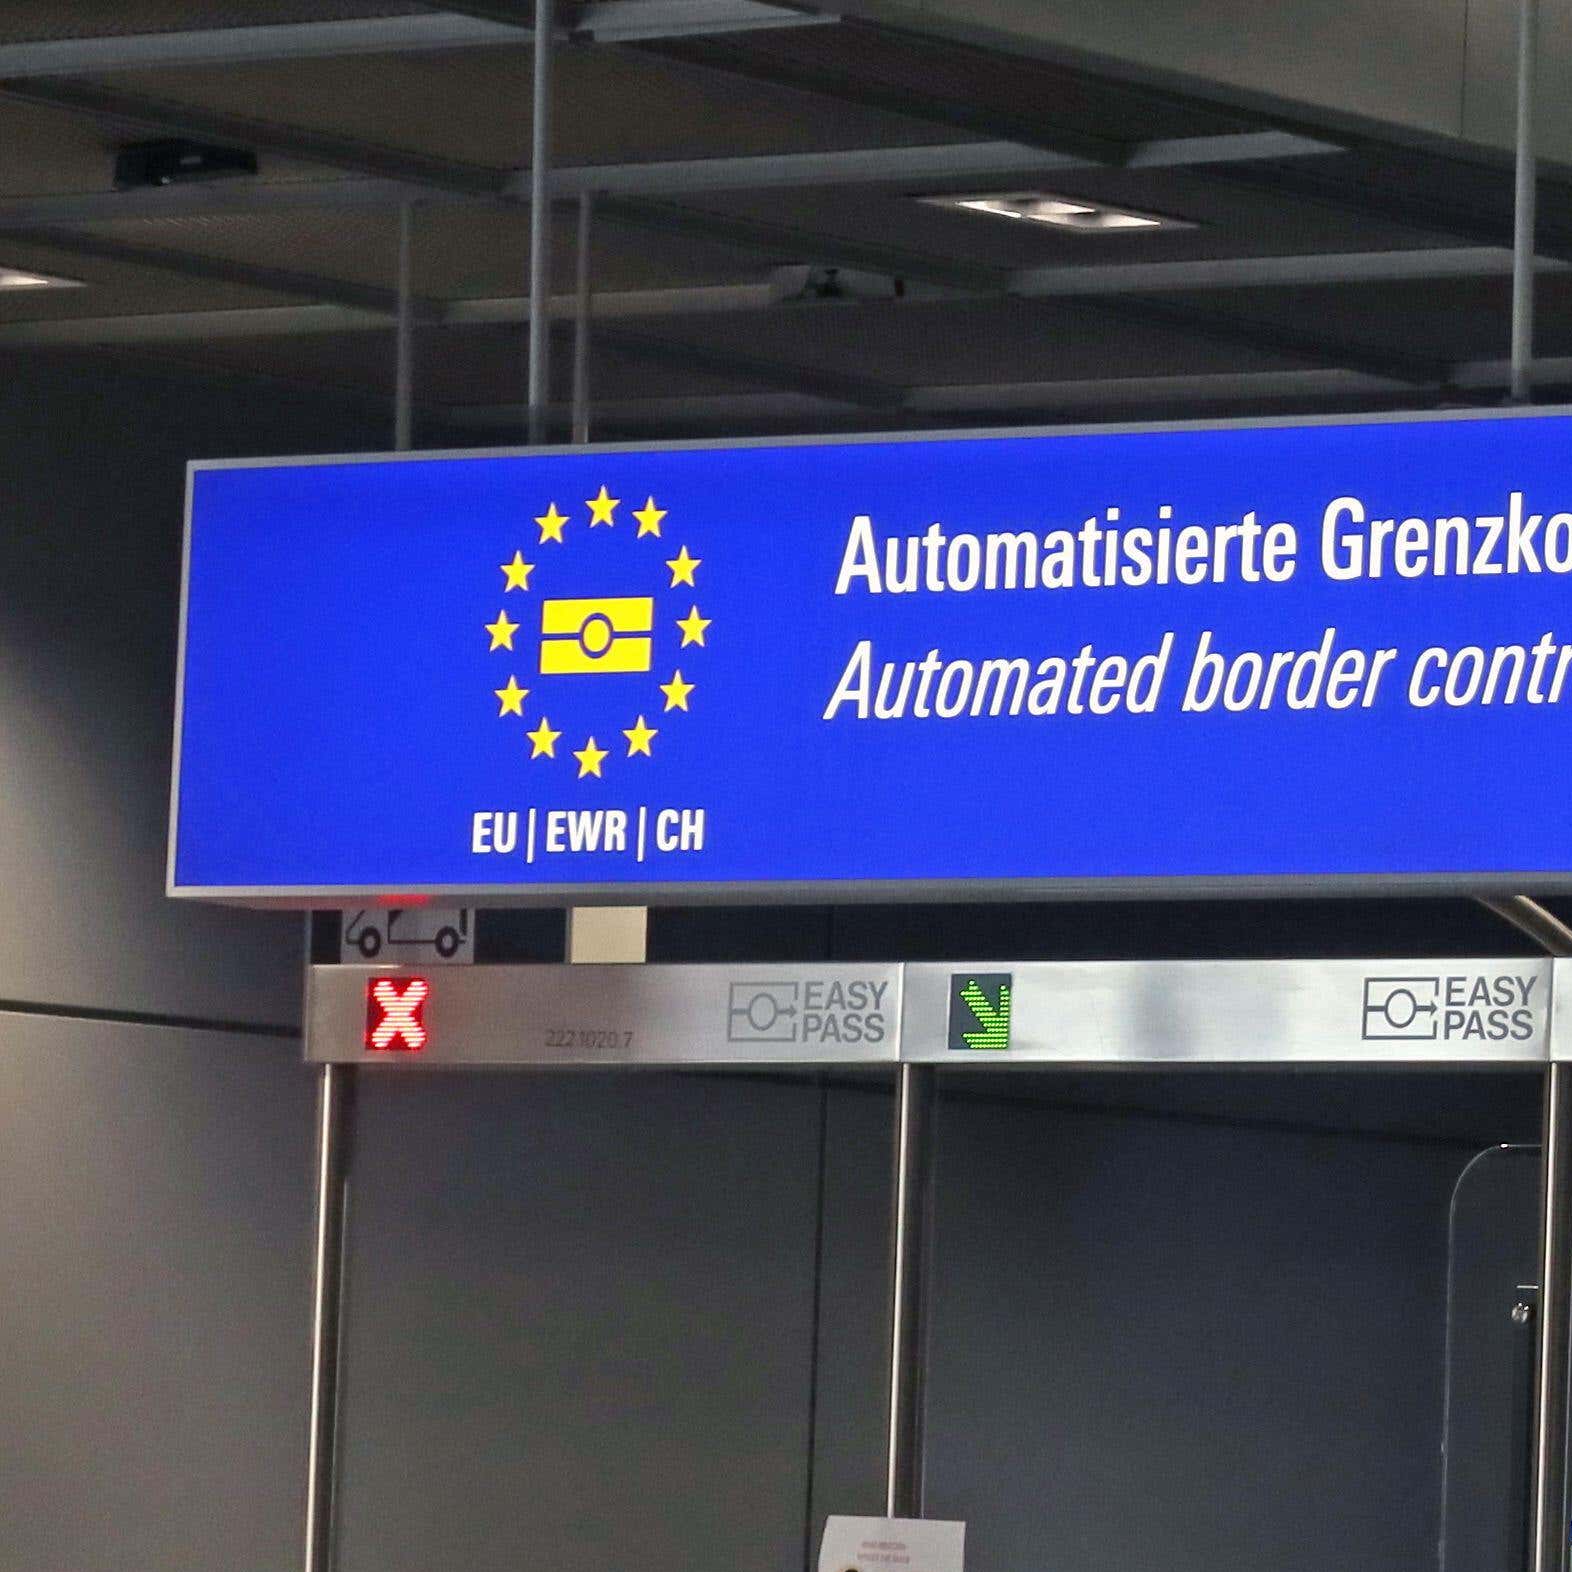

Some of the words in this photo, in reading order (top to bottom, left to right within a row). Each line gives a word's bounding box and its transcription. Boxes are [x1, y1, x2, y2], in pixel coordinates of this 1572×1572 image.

[834, 505, 1298, 595] Automatisierte
[822, 631, 1175, 720] Automated
[1181, 627, 1398, 715] border
[471, 811, 518, 854] EU
[545, 810, 628, 853] EWR
[656, 808, 705, 852] CH
[803, 980, 888, 1011] EASY
[1445, 975, 1538, 1007] EASY
[802, 1013, 886, 1043] PASS
[1444, 1009, 1534, 1040] PASS
